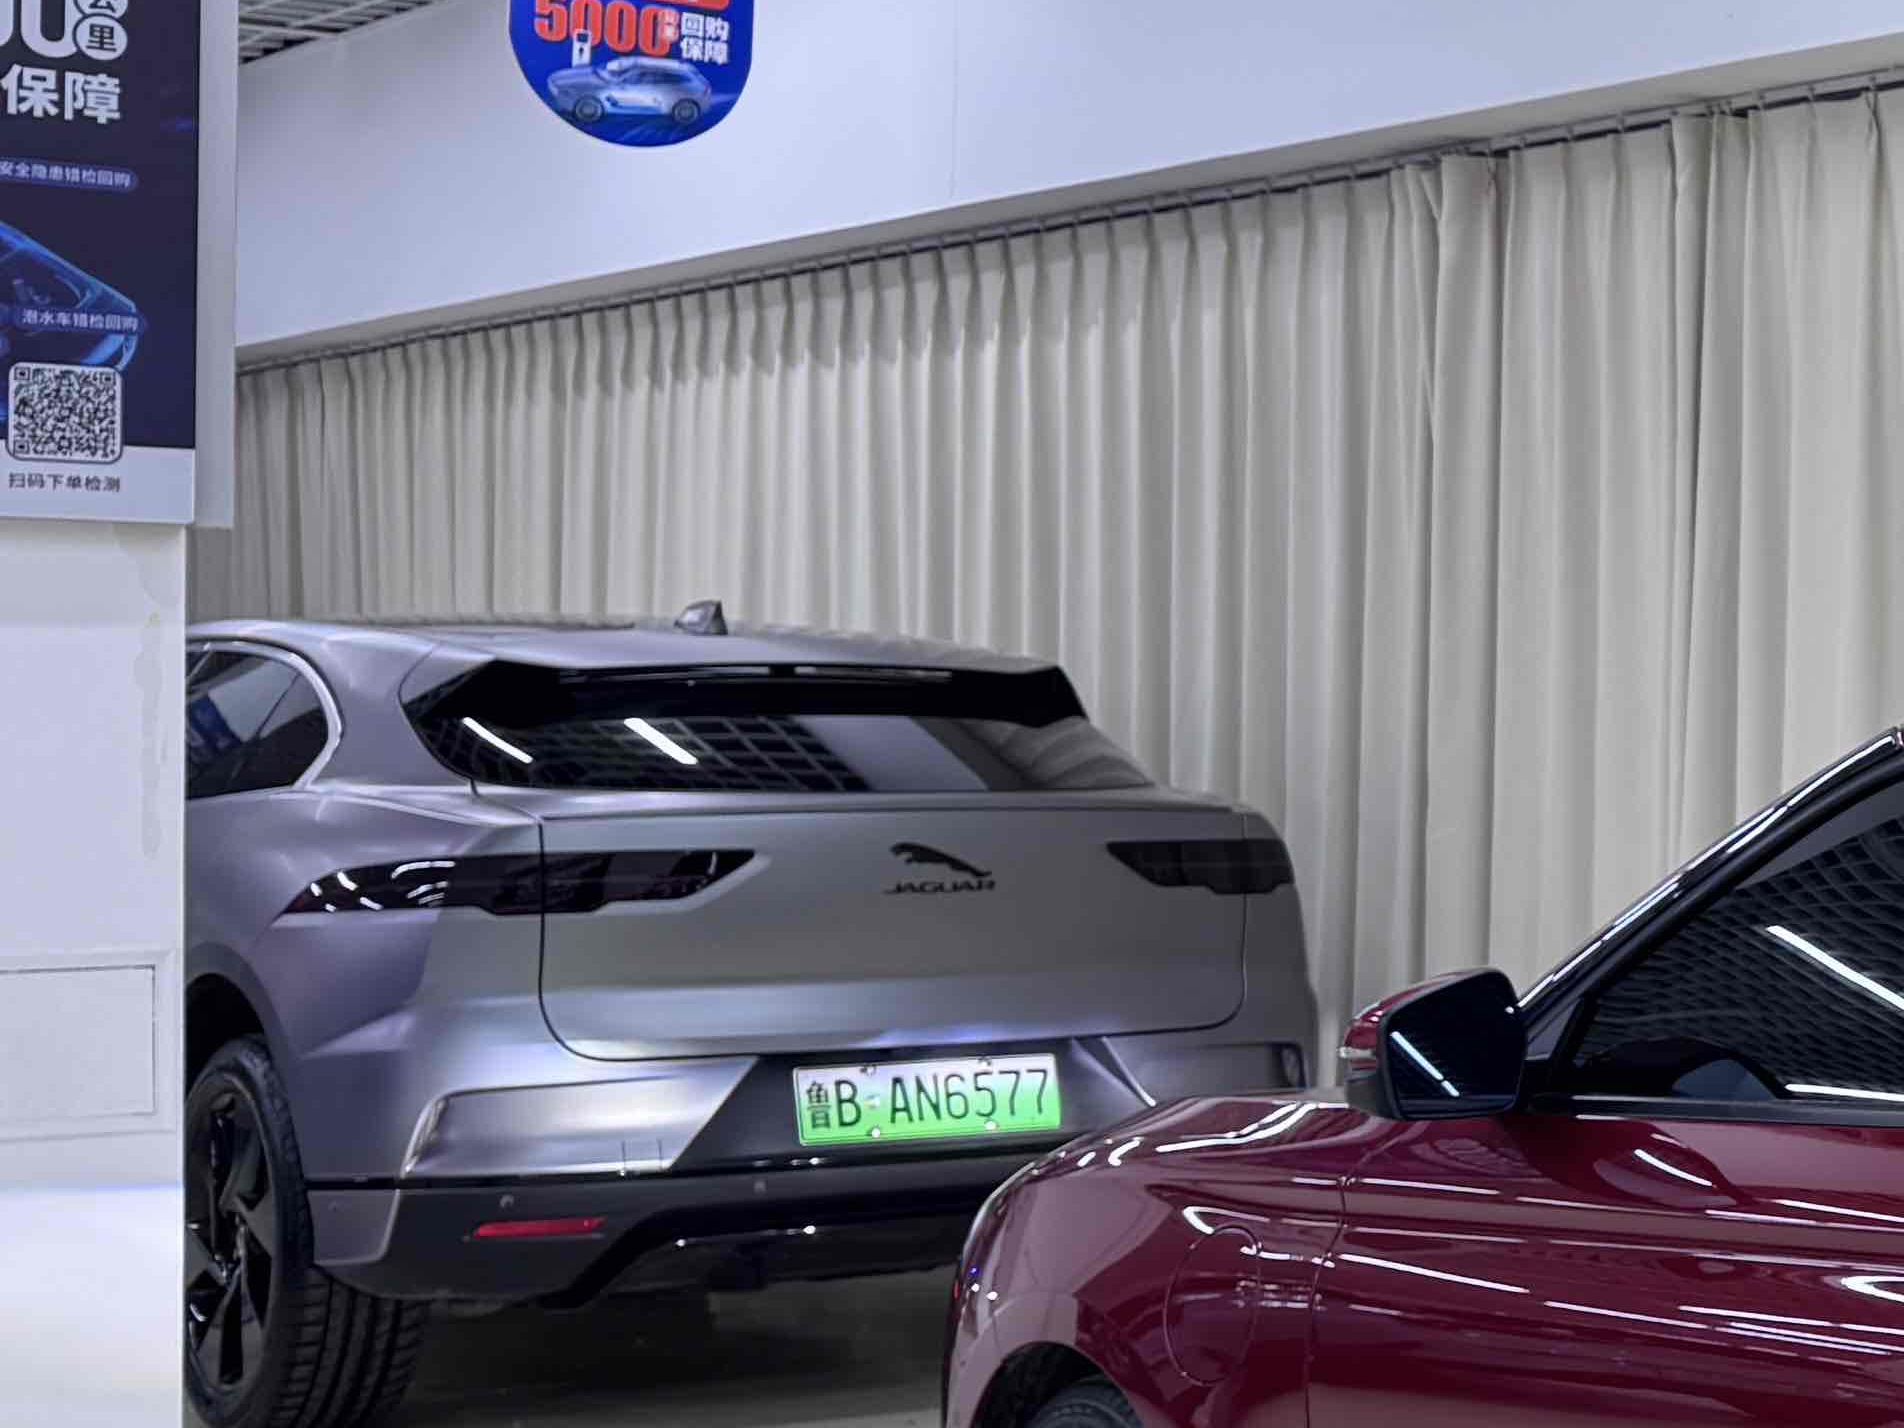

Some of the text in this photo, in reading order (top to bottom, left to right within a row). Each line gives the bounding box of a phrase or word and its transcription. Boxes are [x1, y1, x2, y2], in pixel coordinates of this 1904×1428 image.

[0, 62, 121, 124] 保障
[8, 472, 121, 494] 扫码下单检测
[884, 879, 996, 895] JAGUAR
